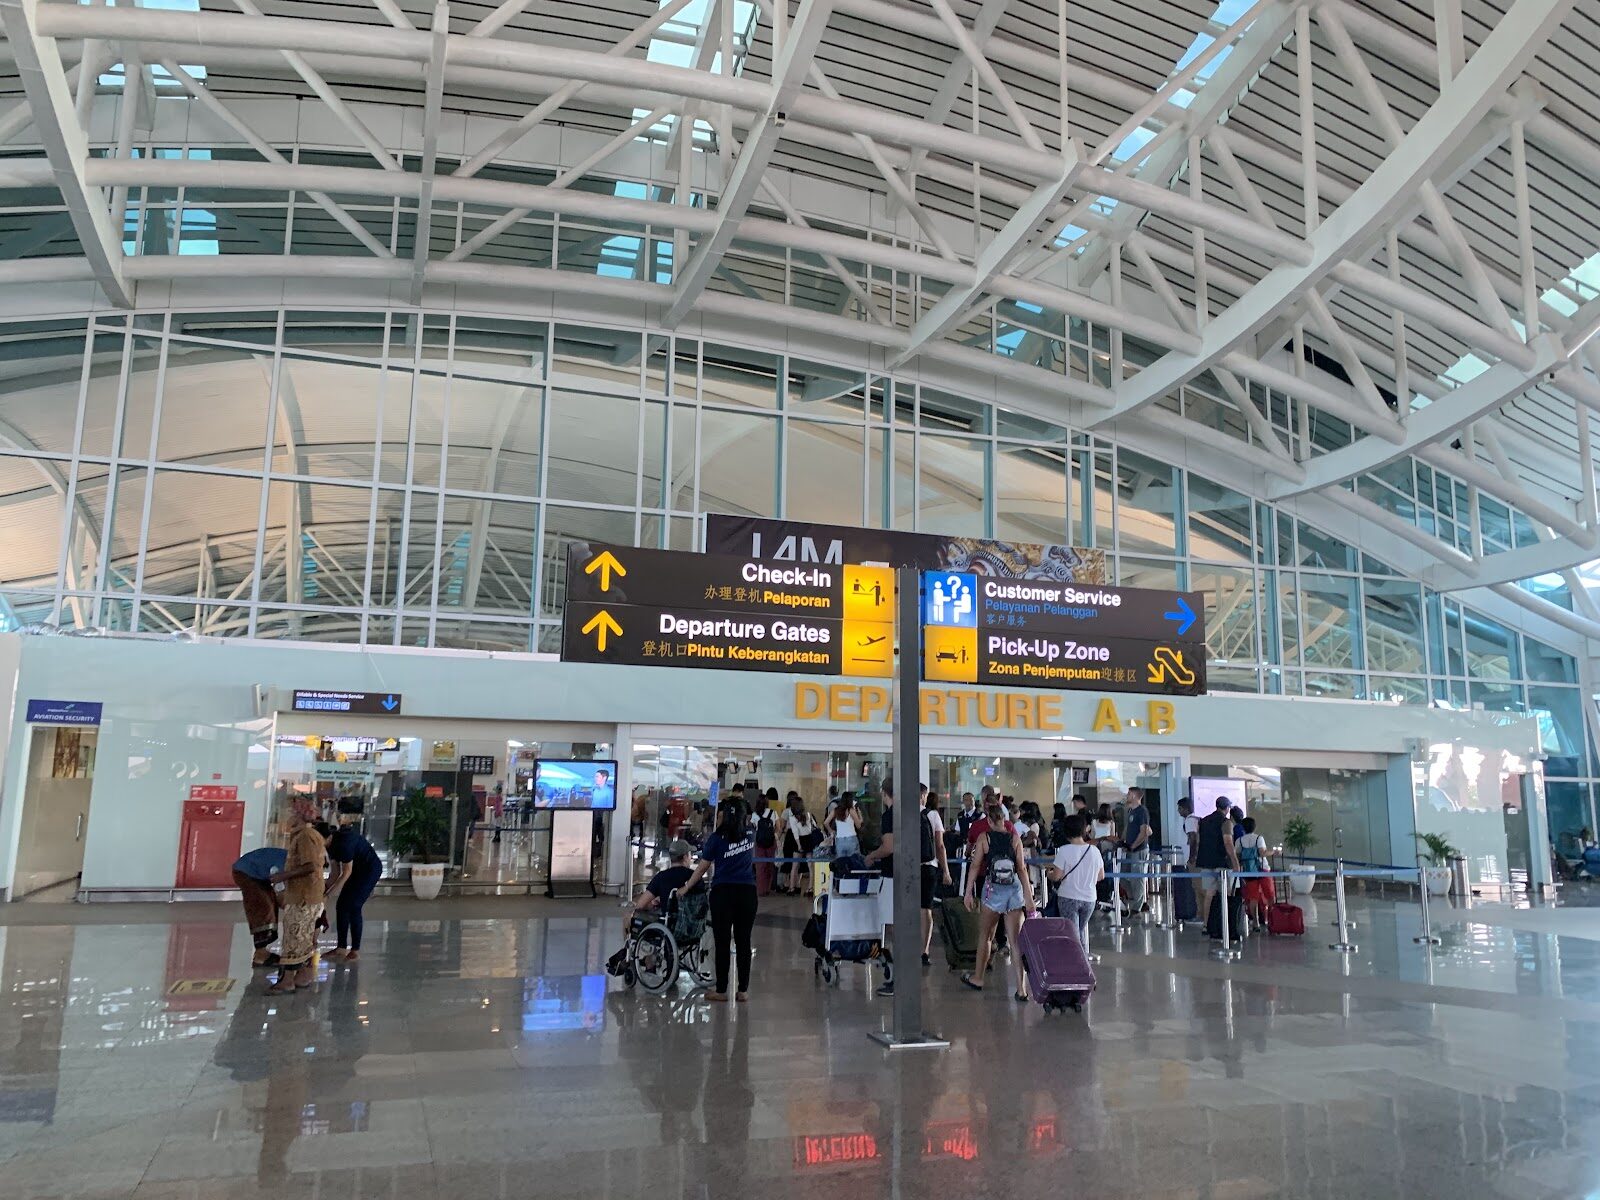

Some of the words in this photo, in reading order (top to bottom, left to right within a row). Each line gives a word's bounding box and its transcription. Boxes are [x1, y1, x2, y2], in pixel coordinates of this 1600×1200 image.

[752, 532, 760, 558] I
[773, 535, 843, 565] AM
[742, 563, 831, 588] Check-In
[704, 584, 761, 603] 办理登机
[763, 590, 831, 608] Pelaporan
[985, 581, 1061, 602] Customer
[1064, 587, 1121, 606] Service
[985, 598, 1040, 613] Pelayanan
[1043, 603, 1098, 619] Pelanggan
[660, 613, 765, 640] Departure
[771, 621, 830, 644] Gates
[642, 640, 687, 657] 登机口
[687, 643, 724, 658] Pintu
[728, 645, 830, 664] Keberangkatan
[988, 636, 1060, 662] Pick-Up
[1064, 641, 1110, 661] Zone
[988, 661, 1020, 675] Zona
[1023, 663, 1101, 680] Penjemputan
[795, 682, 1063, 731] DEPRTURE
